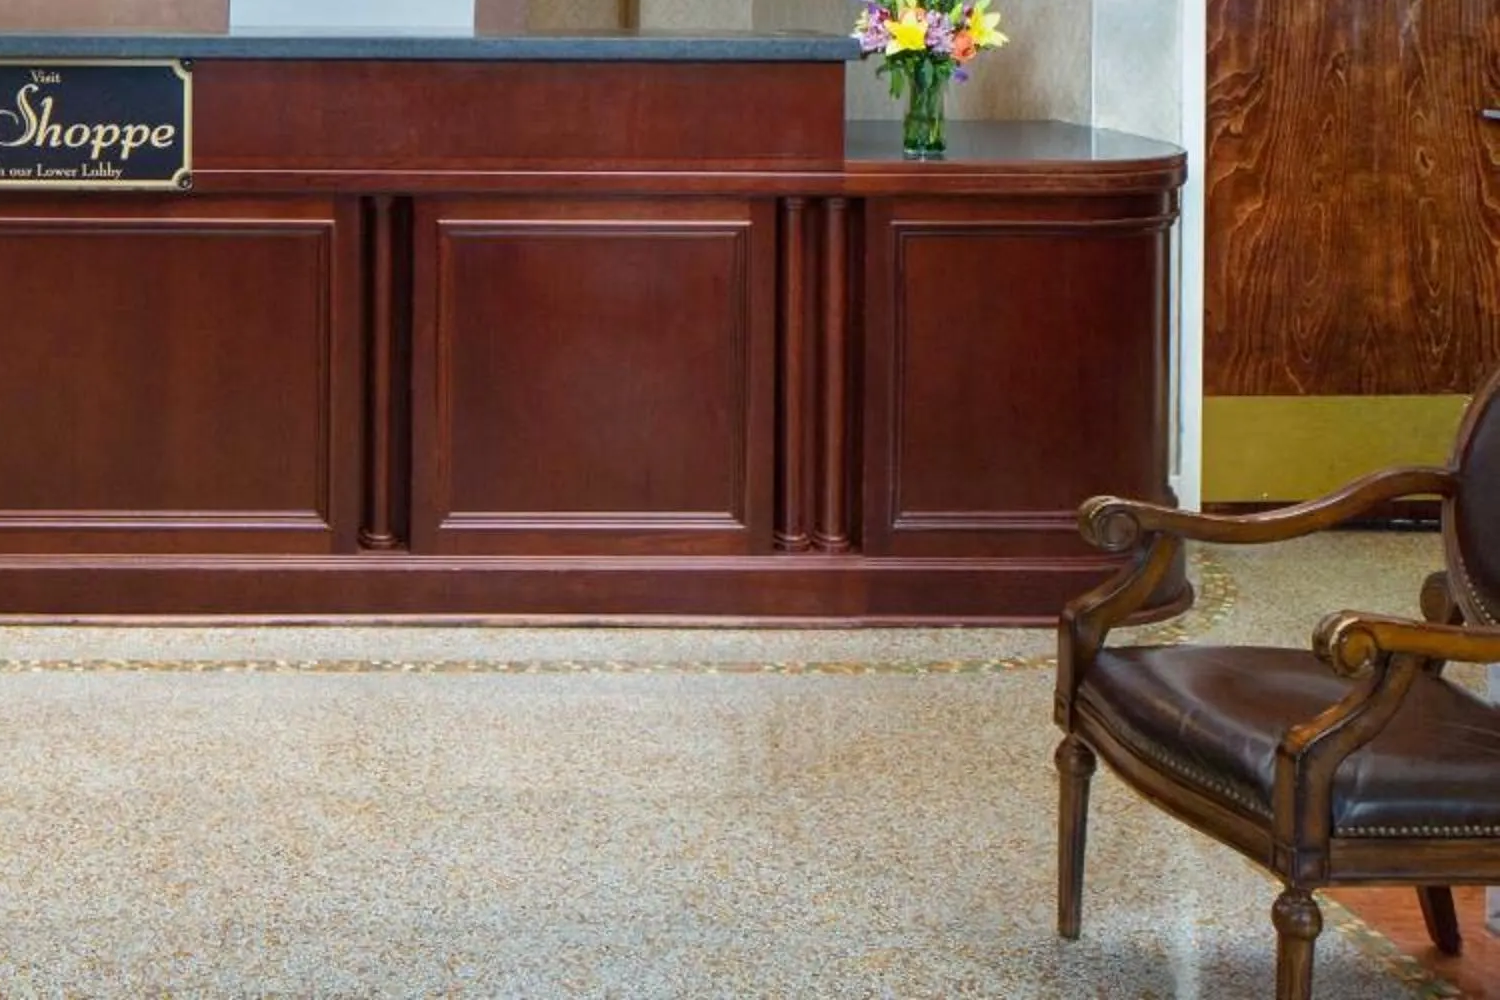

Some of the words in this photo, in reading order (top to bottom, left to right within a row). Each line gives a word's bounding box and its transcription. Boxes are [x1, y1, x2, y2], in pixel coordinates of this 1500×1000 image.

[30, 70, 61, 84] Visit
[9, 167, 33, 178] our
[36, 163, 79, 178] Lower
[81, 163, 124, 179] Lobby
